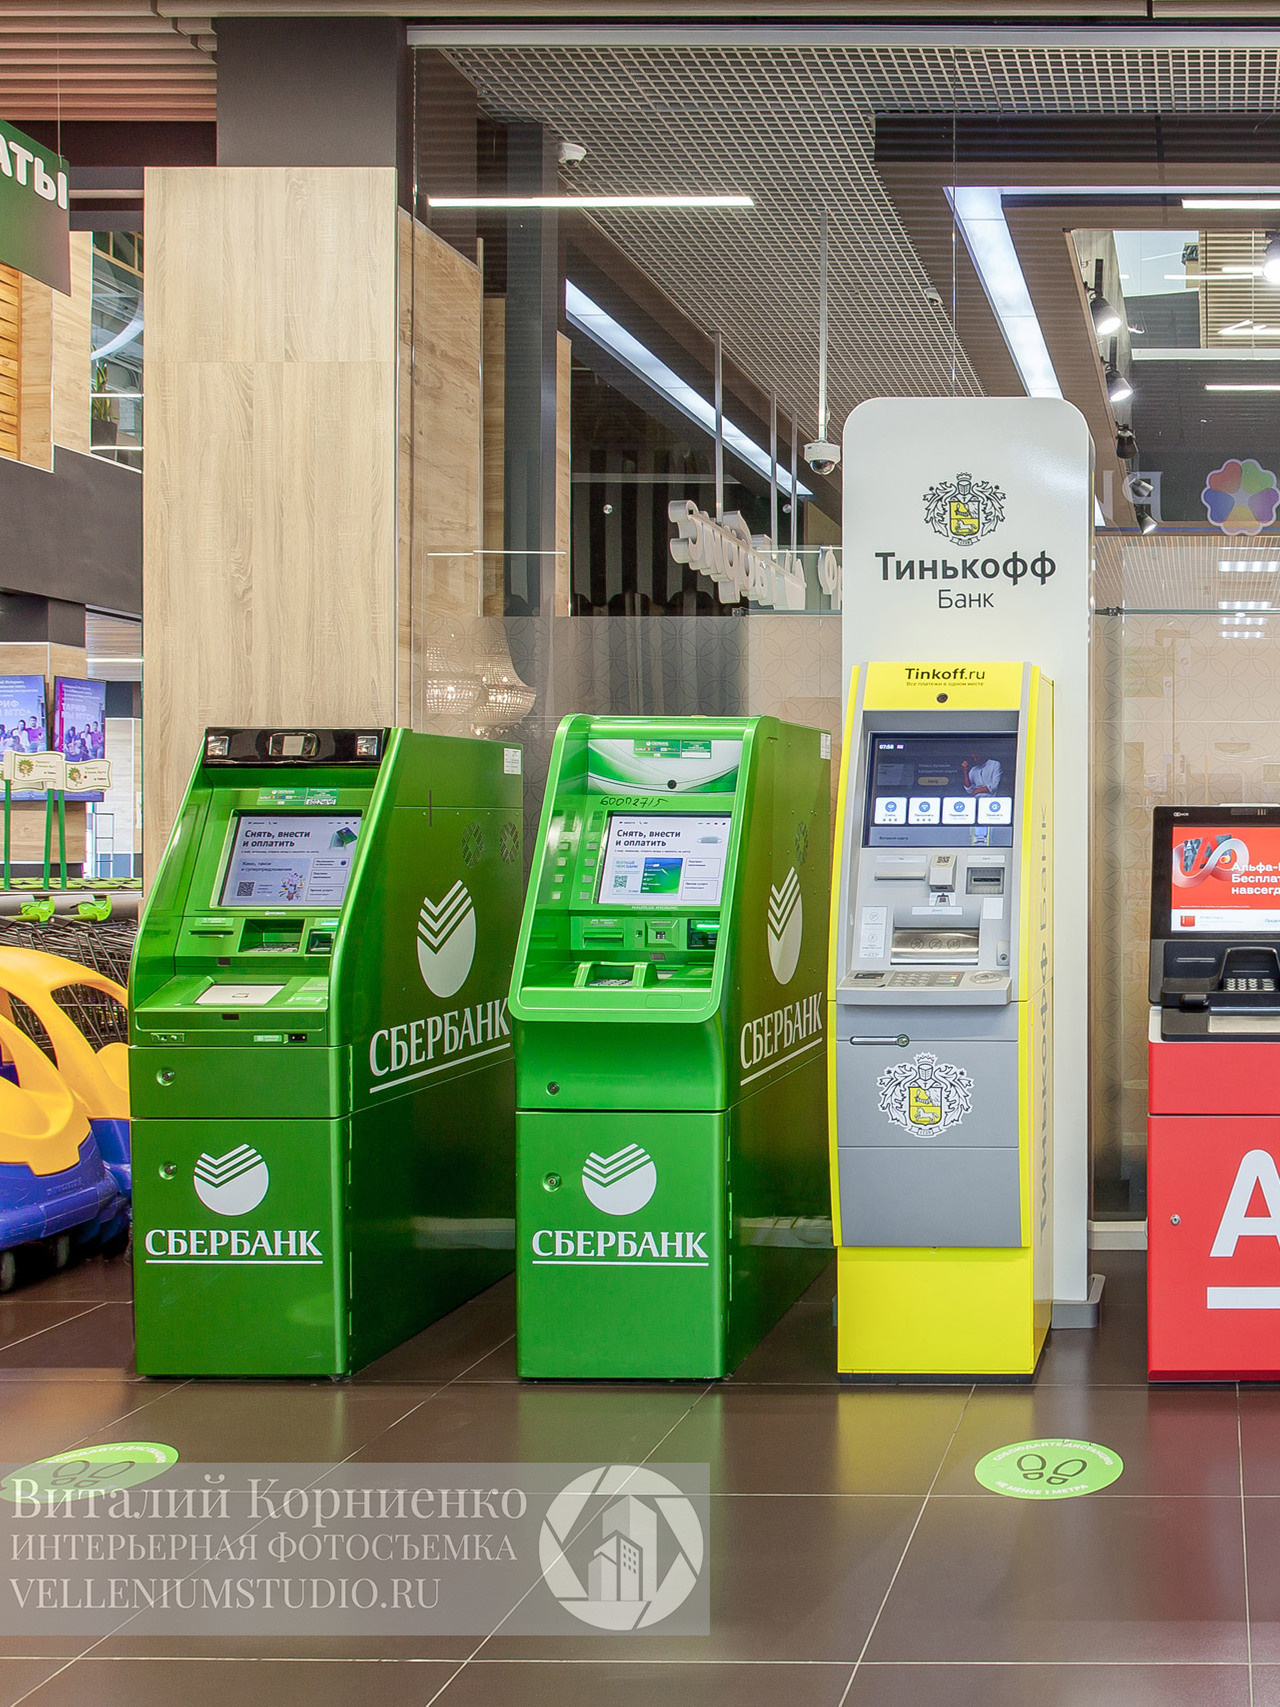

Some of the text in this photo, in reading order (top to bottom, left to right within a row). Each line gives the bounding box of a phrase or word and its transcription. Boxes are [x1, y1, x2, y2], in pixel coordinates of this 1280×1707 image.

[874, 550, 1057, 586] Тинькофф
[938, 589, 994, 609] Банк
[905, 668, 985, 680] Tinkoff.ru
[245, 830, 275, 839] Снять,
[617, 829, 646, 838] Снять,
[369, 997, 511, 1077] СБЕРБАНК
[740, 992, 823, 1069] СБЕРБАНК
[144, 1229, 323, 1257] СБЕРБАНК
[531, 1230, 709, 1258] СБЕРБАНК
